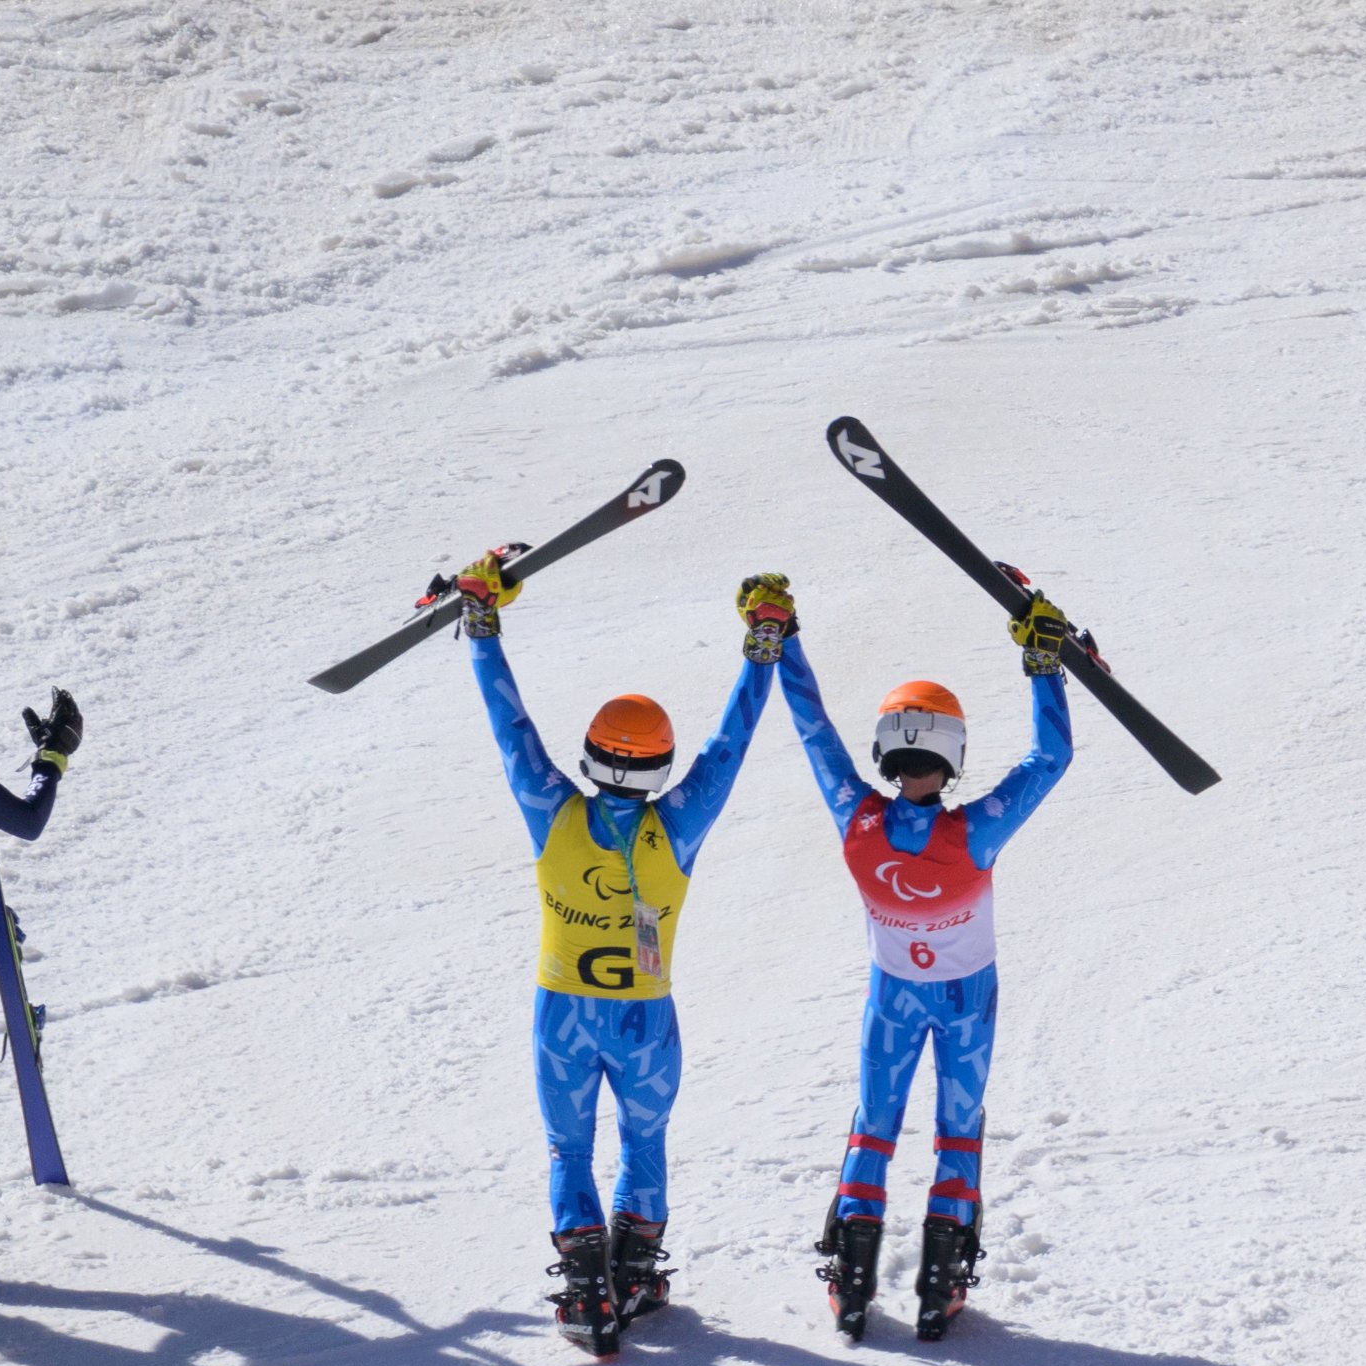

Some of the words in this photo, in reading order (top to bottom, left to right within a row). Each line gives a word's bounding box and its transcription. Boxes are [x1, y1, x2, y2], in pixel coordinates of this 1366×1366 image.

[544, 890, 611, 930] BEIJING
[925, 910, 975, 932] 2022
[577, 946, 635, 991] G
[910, 941, 936, 970] 6
